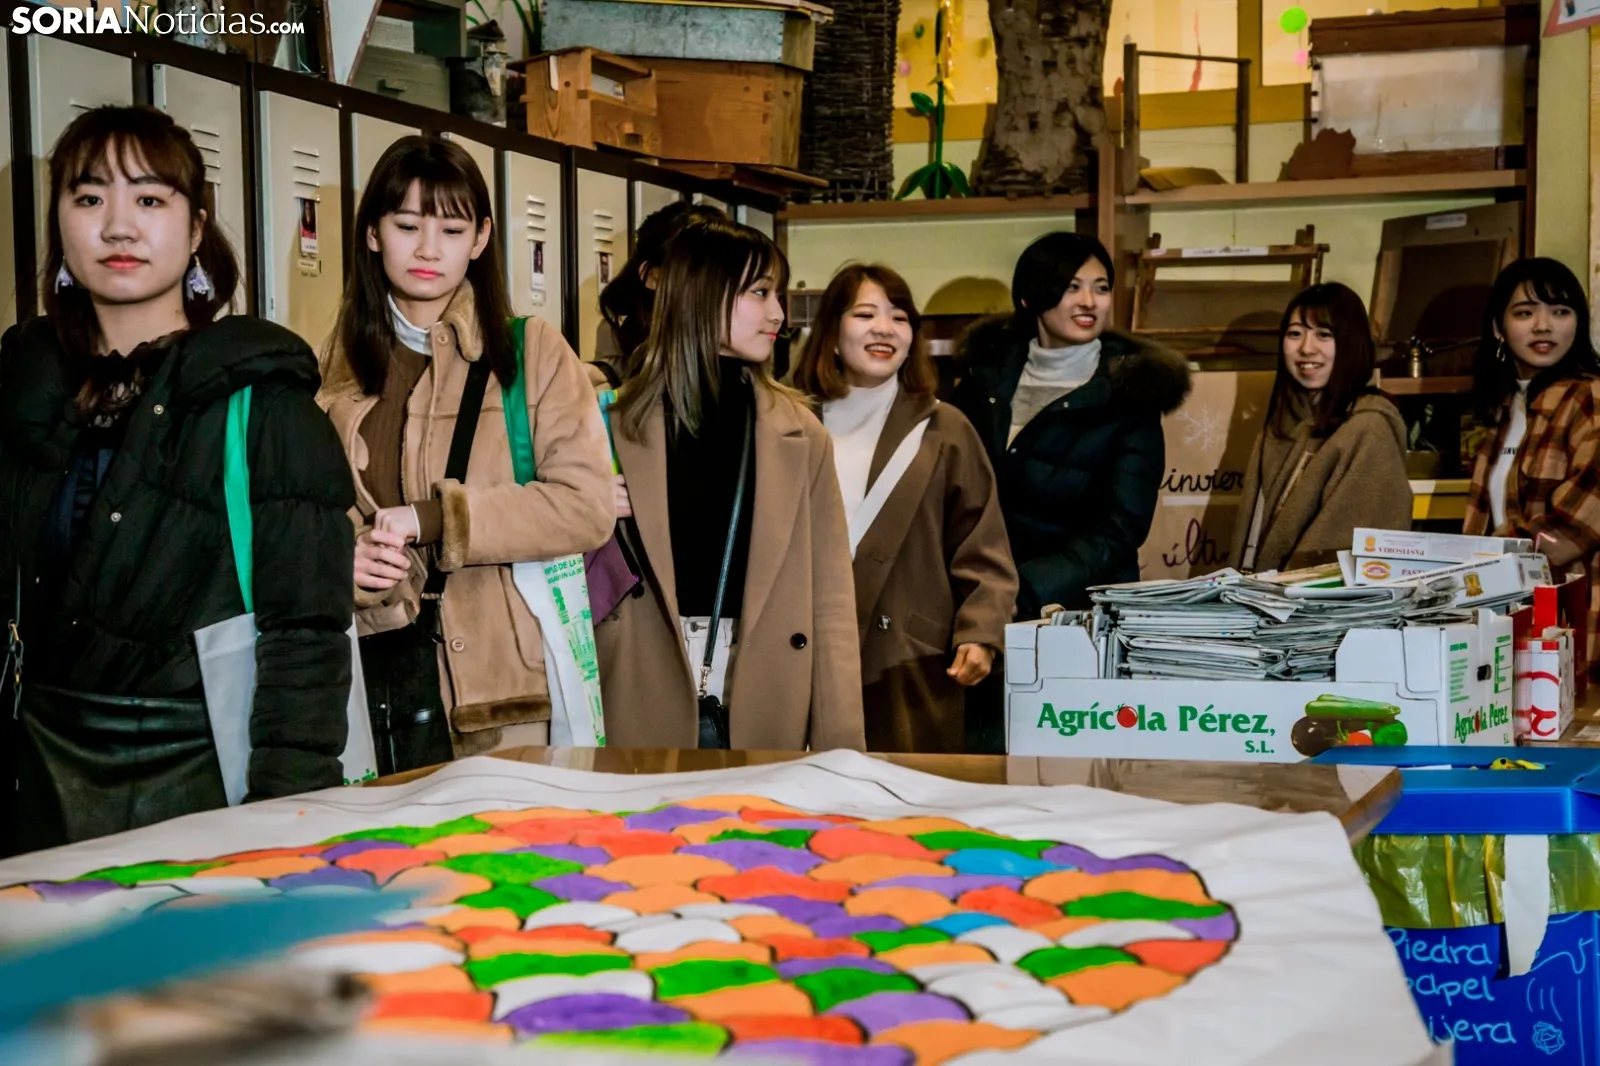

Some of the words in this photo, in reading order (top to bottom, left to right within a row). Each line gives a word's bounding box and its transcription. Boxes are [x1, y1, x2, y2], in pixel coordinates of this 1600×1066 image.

[1036, 701, 1167, 737] Agrícola
[1178, 703, 1276, 736] Pérez,
[1244, 739, 1275, 754] S.L.
[1406, 973, 1496, 1007] apel
